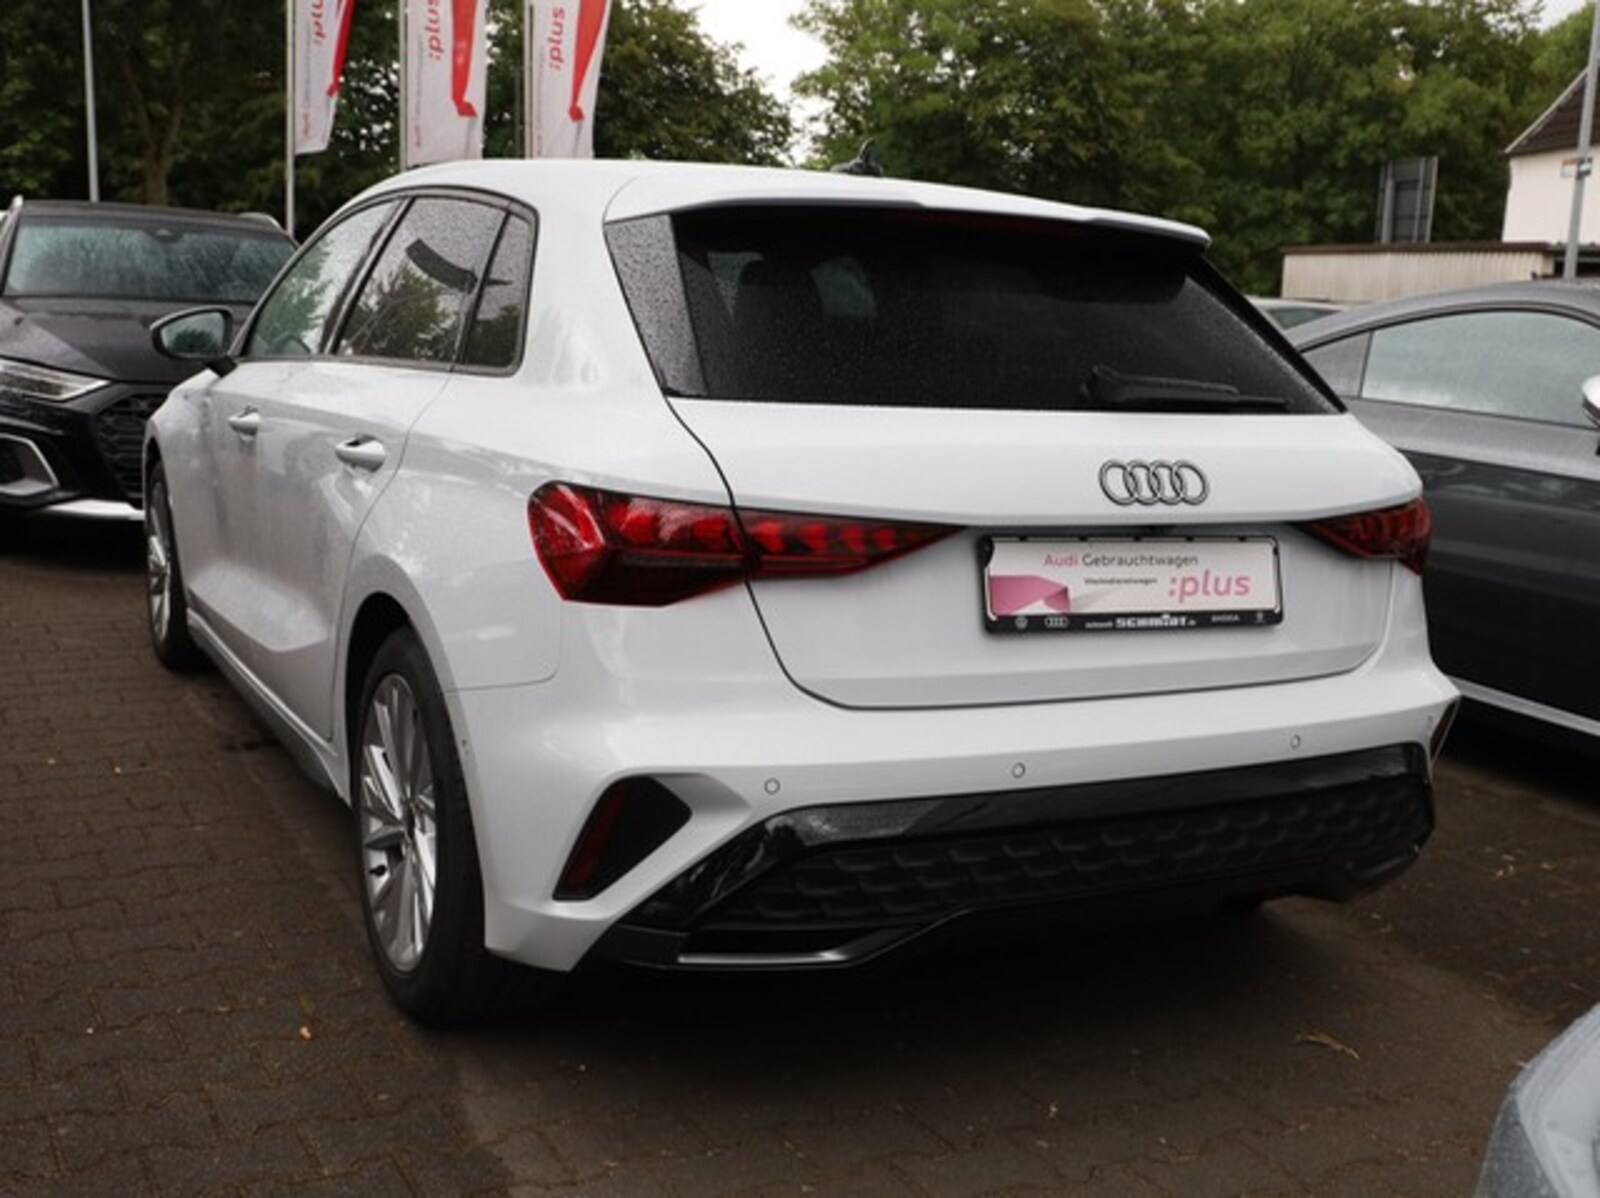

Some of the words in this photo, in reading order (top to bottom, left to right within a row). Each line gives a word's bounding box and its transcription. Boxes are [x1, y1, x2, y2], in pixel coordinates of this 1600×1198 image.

[1043, 553, 1079, 567] Audi
[1082, 553, 1198, 568] Gebrauchtwagen
[1168, 569, 1251, 603] :plus
